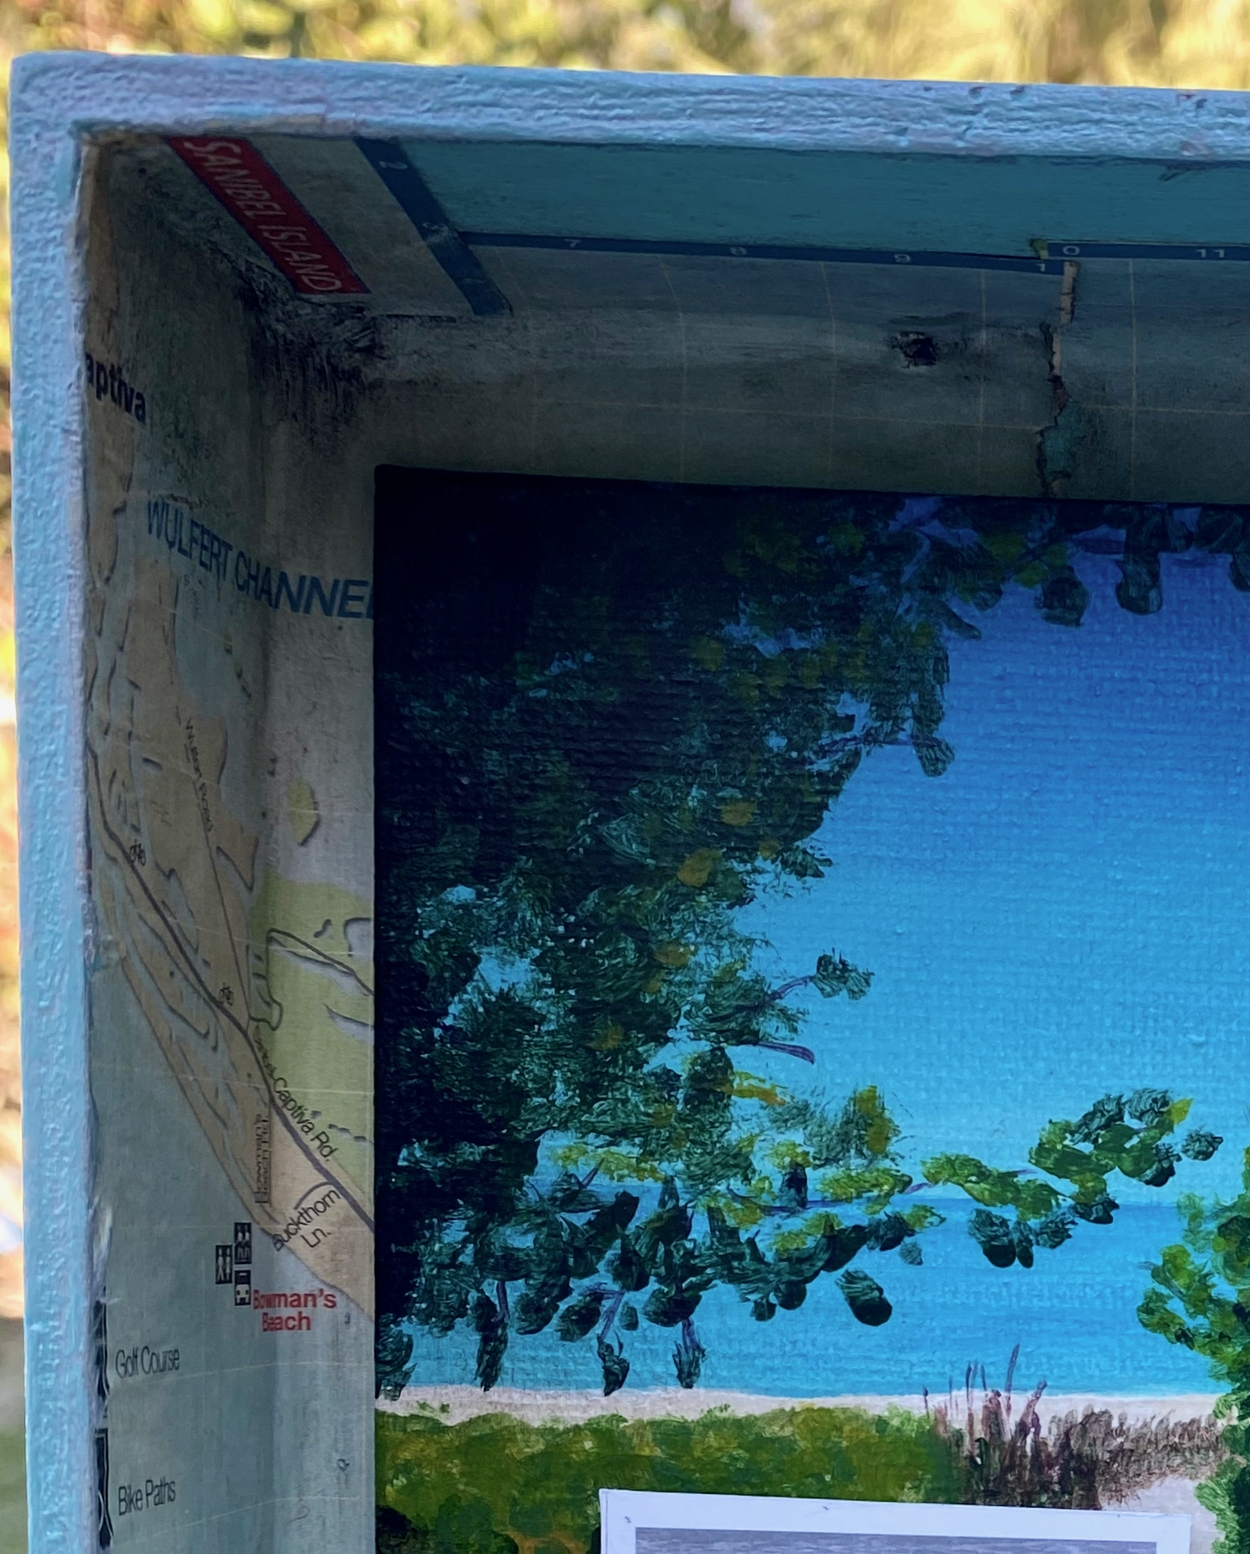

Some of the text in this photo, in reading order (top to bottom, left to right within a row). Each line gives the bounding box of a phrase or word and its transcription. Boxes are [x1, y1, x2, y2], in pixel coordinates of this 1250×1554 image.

[184, 141, 343, 291] SANIBEL ISLAND
[1195, 249, 1225, 258] 11
[147, 499, 234, 581] WULFERT
[310, 1130, 339, 1162] Rd.
[273, 1189, 341, 1251] Buckthorn
[300, 1227, 331, 1249] Ln.
[253, 1288, 337, 1311] Bowman's
[262, 1311, 311, 1332] Beach
[115, 1345, 181, 1378] Golf Course
[118, 1476, 176, 1517] Bike Paths
